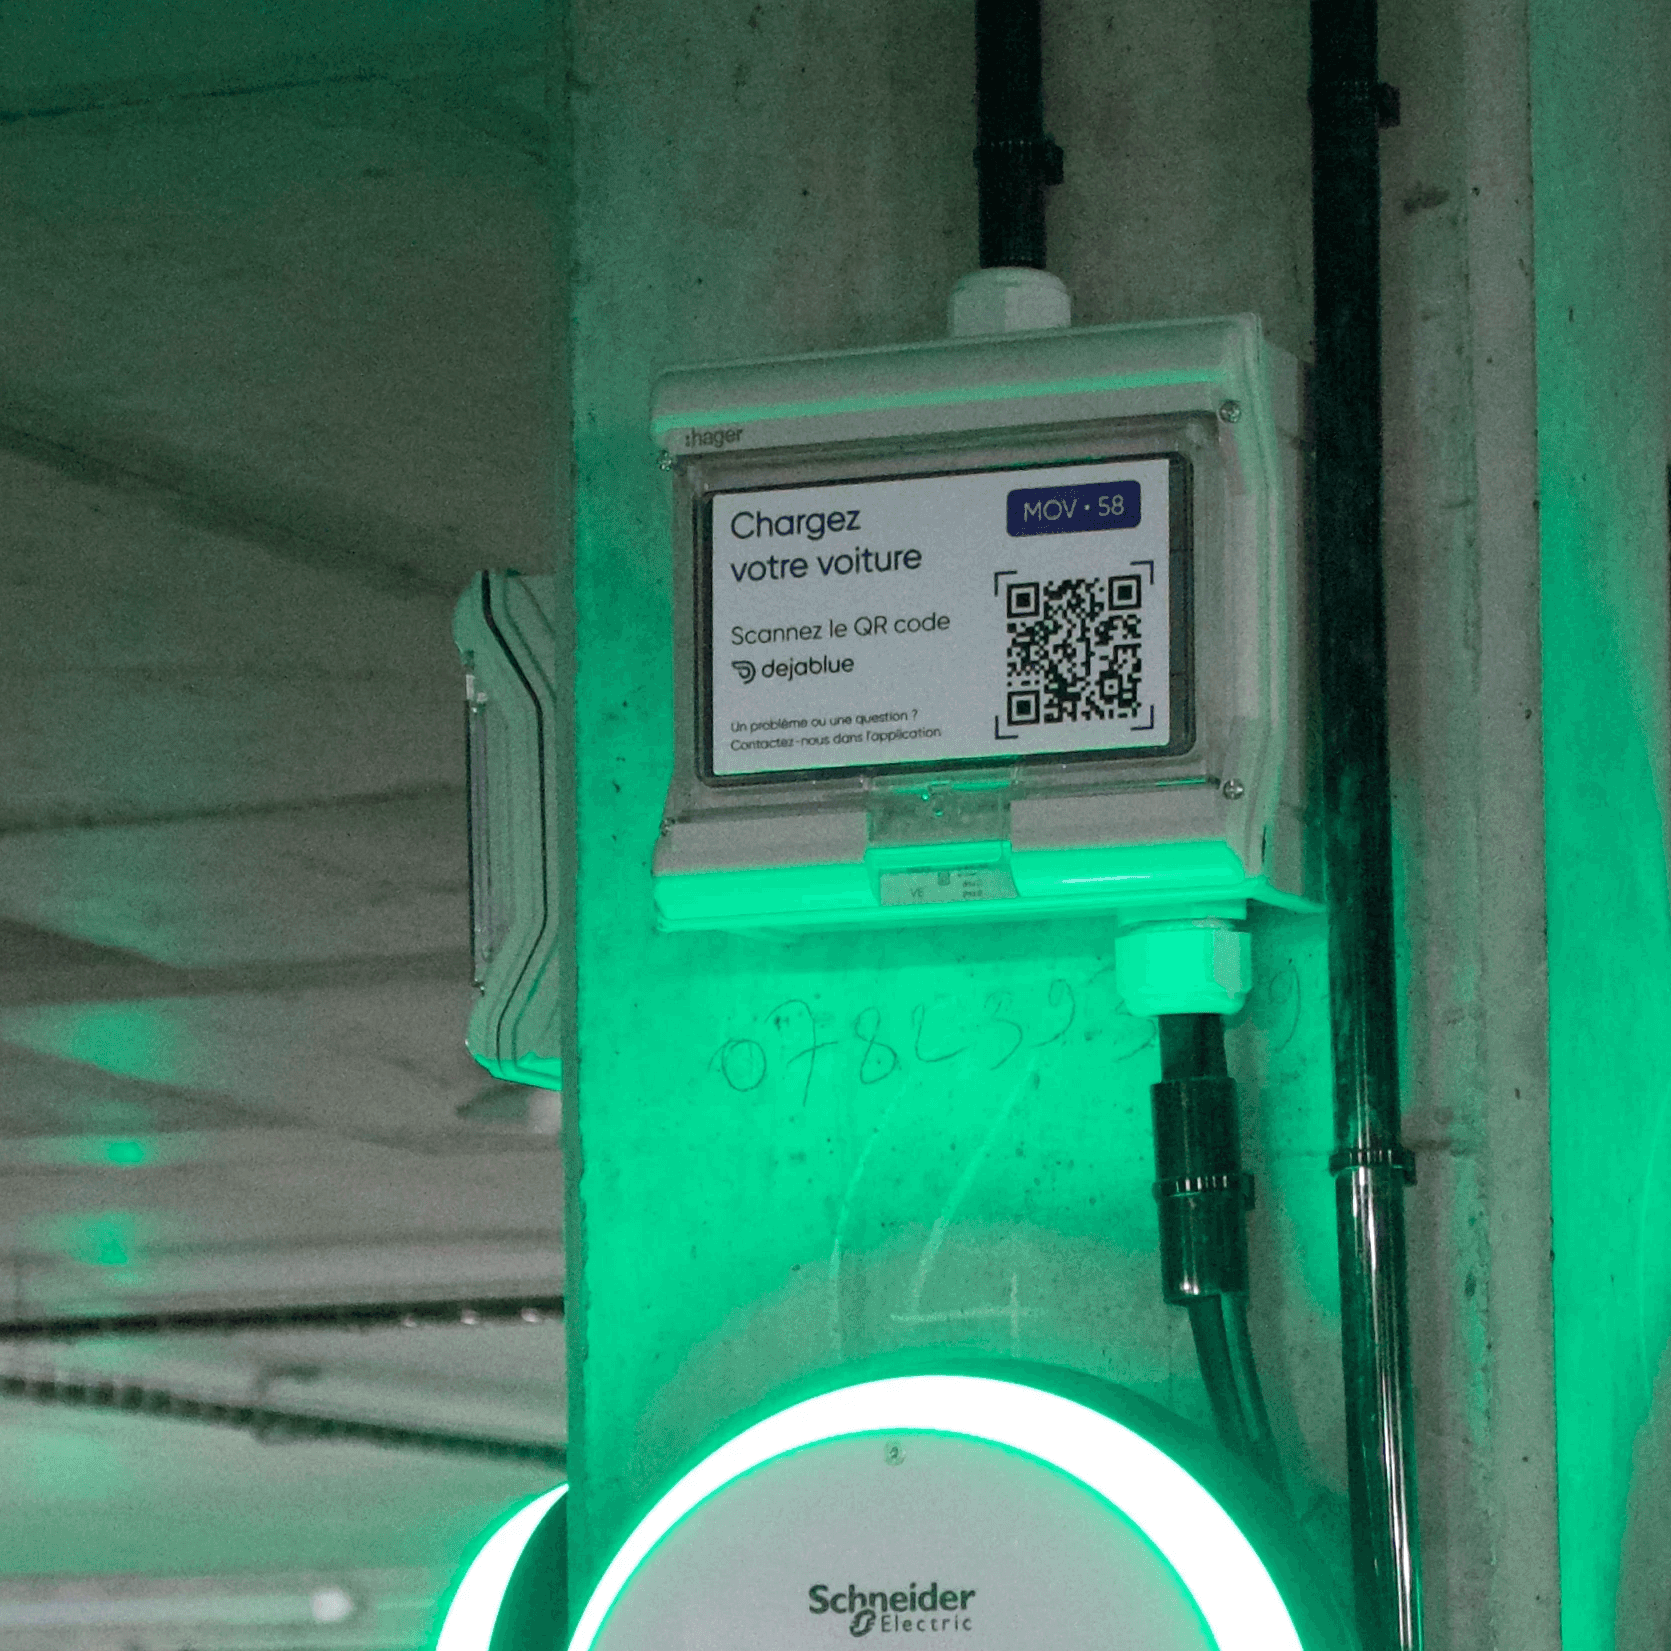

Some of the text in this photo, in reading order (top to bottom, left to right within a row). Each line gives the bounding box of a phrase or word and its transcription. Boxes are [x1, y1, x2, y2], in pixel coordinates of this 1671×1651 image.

[1024, 499, 1077, 522] MOV
[1098, 494, 1125, 517] 58
[731, 510, 861, 541] Chargez
[730, 546, 923, 582] votre voiture
[731, 612, 951, 646] Scannez le QR code
[761, 654, 855, 681] dejablue
[730, 721, 747, 733] Un
[811, 717, 826, 728] ou
[830, 715, 851, 726] une
[855, 711, 908, 728] question
[730, 735, 830, 751] Contactez-nous
[833, 732, 863, 745] dans
[808, 1582, 976, 1614] Schneider
[881, 1614, 973, 1633] Electric
